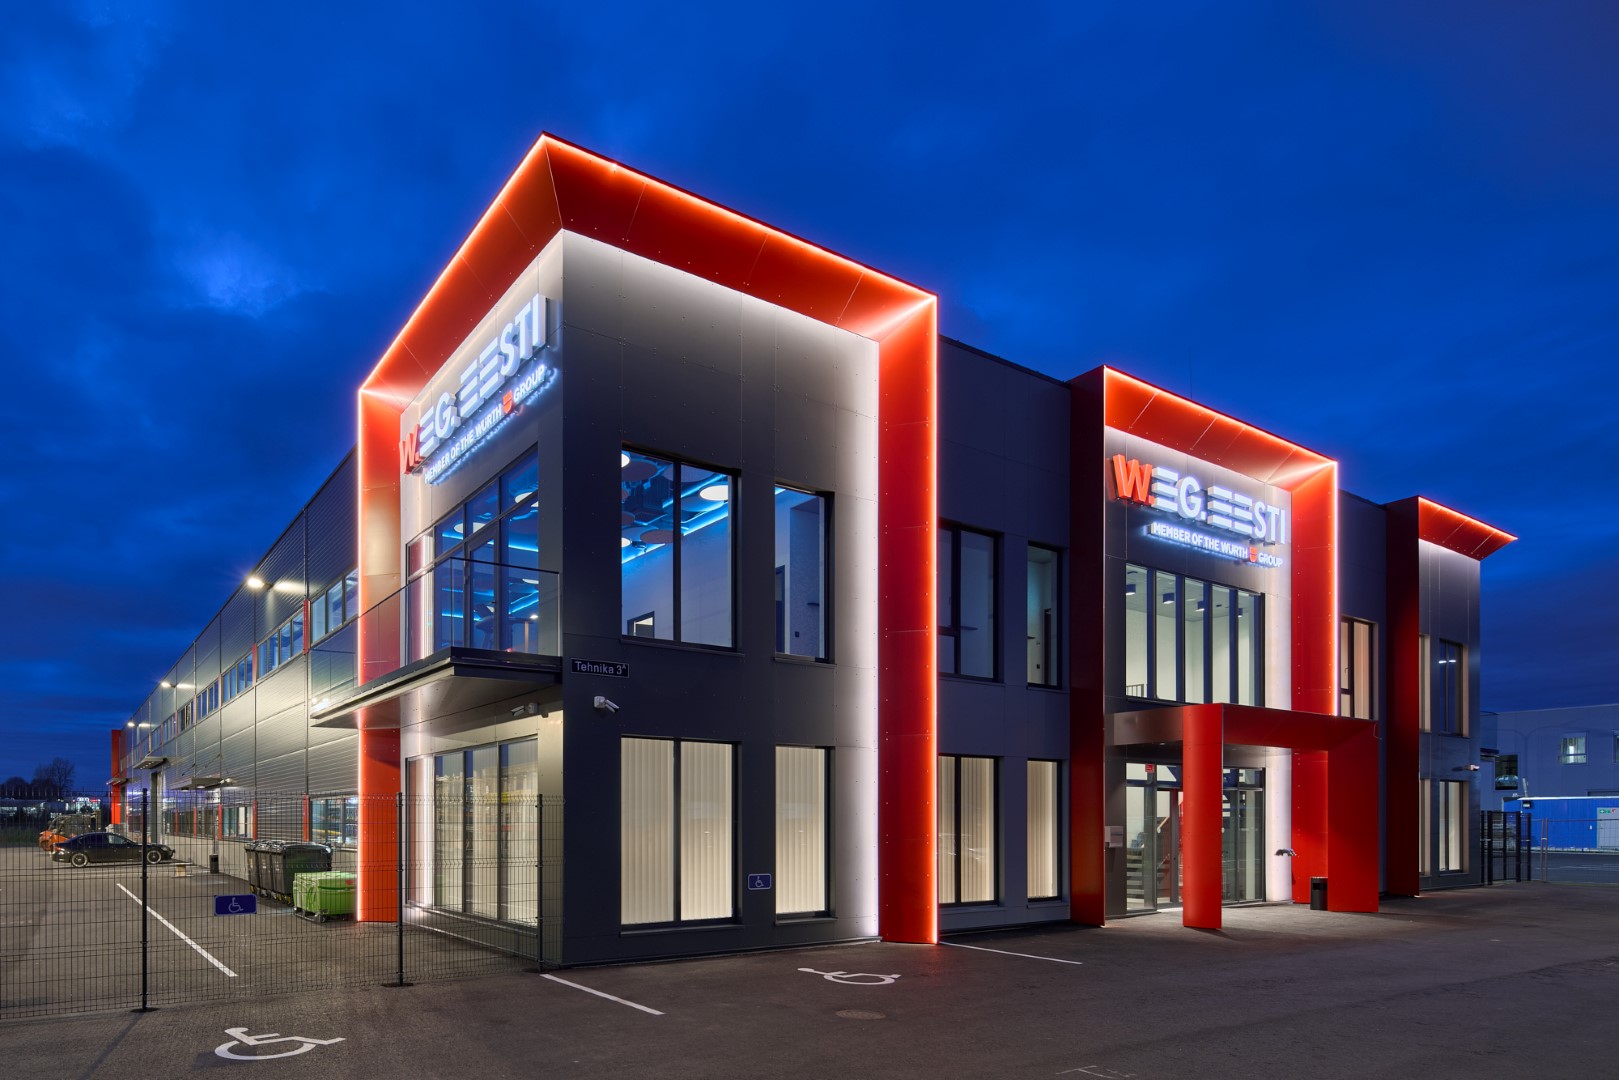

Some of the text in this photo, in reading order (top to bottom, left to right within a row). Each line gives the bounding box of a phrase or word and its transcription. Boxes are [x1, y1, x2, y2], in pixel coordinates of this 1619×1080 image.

[425, 453, 450, 484] MEMBER
[450, 443, 460, 463] OF
[459, 430, 474, 454] THE
[514, 364, 545, 401] GROUP
[1151, 522, 1191, 542] MEMBER
[1191, 532, 1203, 546] OF
[1204, 535, 1219, 551] THE
[1258, 552, 1283, 567] GROUP
[575, 661, 614, 674] Tehnika
